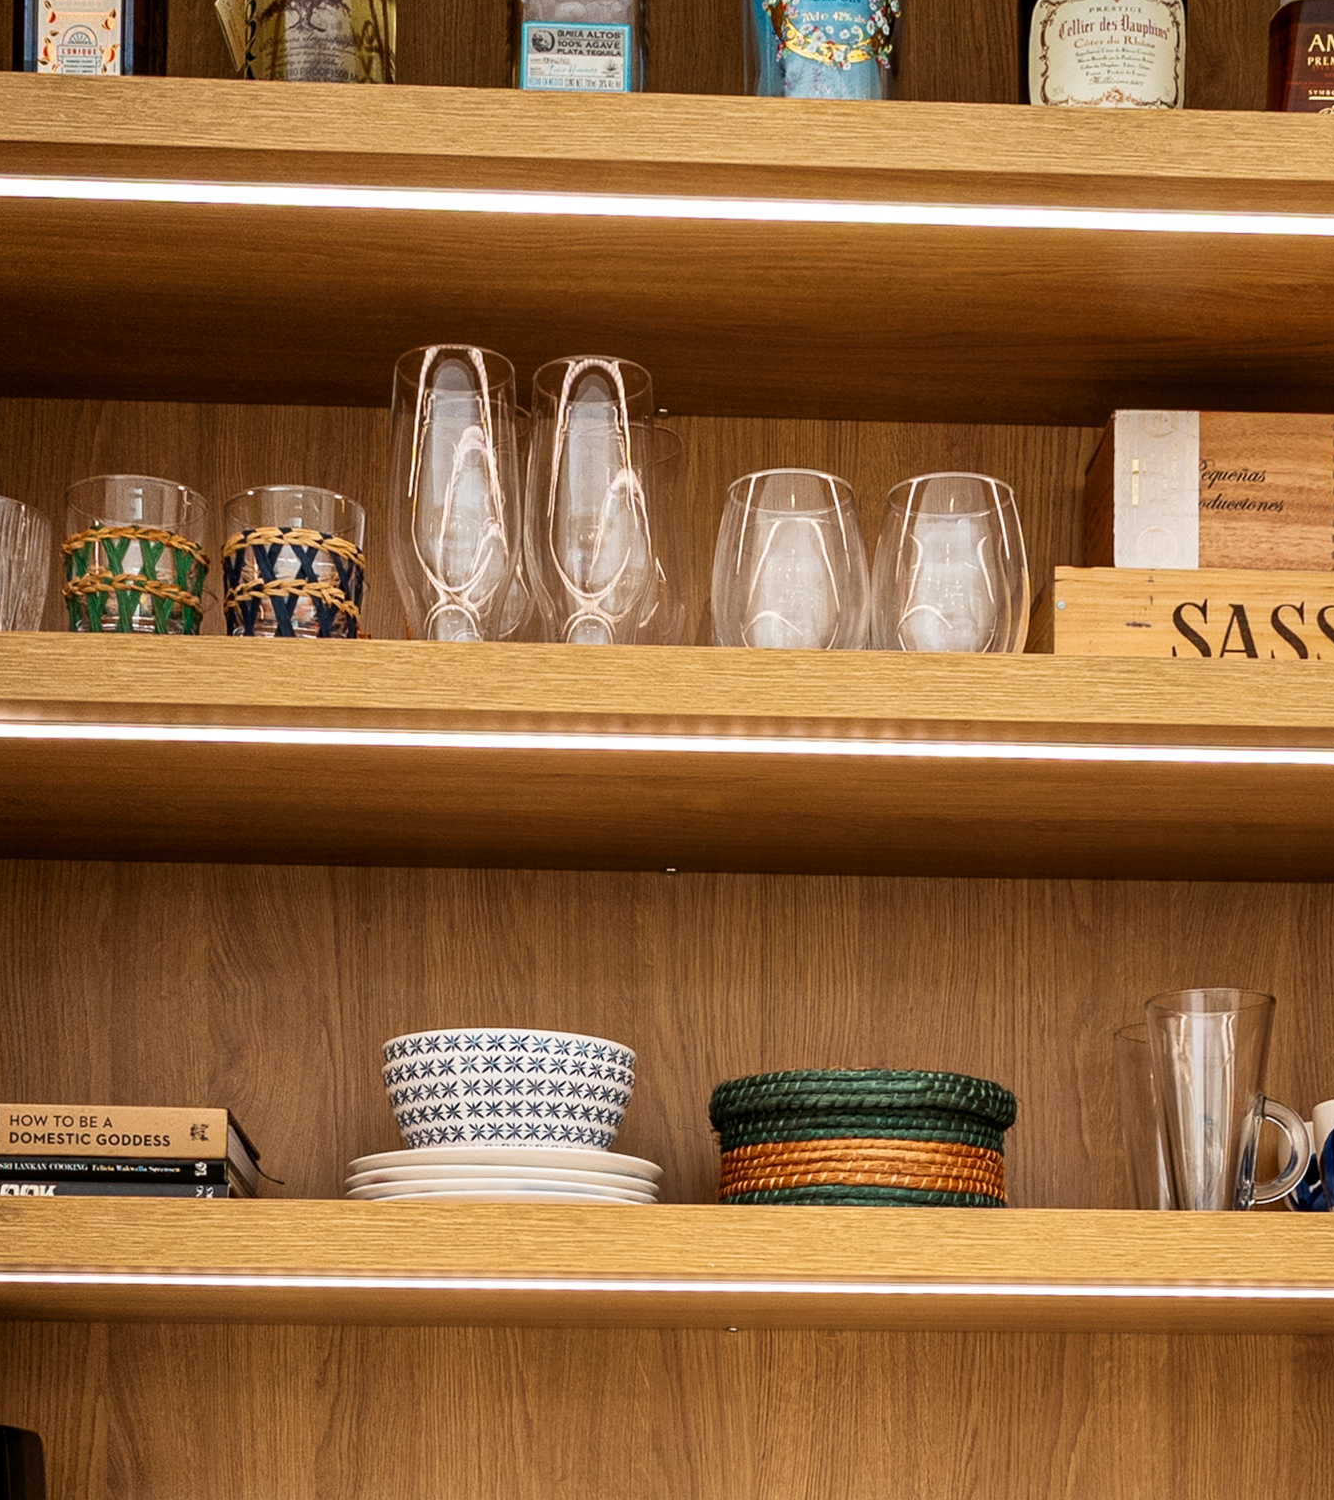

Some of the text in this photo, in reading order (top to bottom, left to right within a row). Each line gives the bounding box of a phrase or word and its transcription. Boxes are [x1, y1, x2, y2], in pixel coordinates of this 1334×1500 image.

[1088, 5, 1144, 14] PRESTIGE
[1099, 16, 1118, 32] des
[1120, 13, 1168, 41] Dauphins
[586, 30, 622, 39] ALTOS
[557, 40, 621, 50] 100% AGAVE
[1107, 35, 1120, 45] du
[557, 48, 622, 57] PLATA TEQUILA
[1199, 492, 1285, 513] oducciones
[9, 1114, 113, 1128] HOW TO BE A
[9, 1131, 171, 1147] DOMESTIC GODDESS
[14, 1162, 48, 1171] LANKAN
[48, 1163, 88, 1171] COOKING
